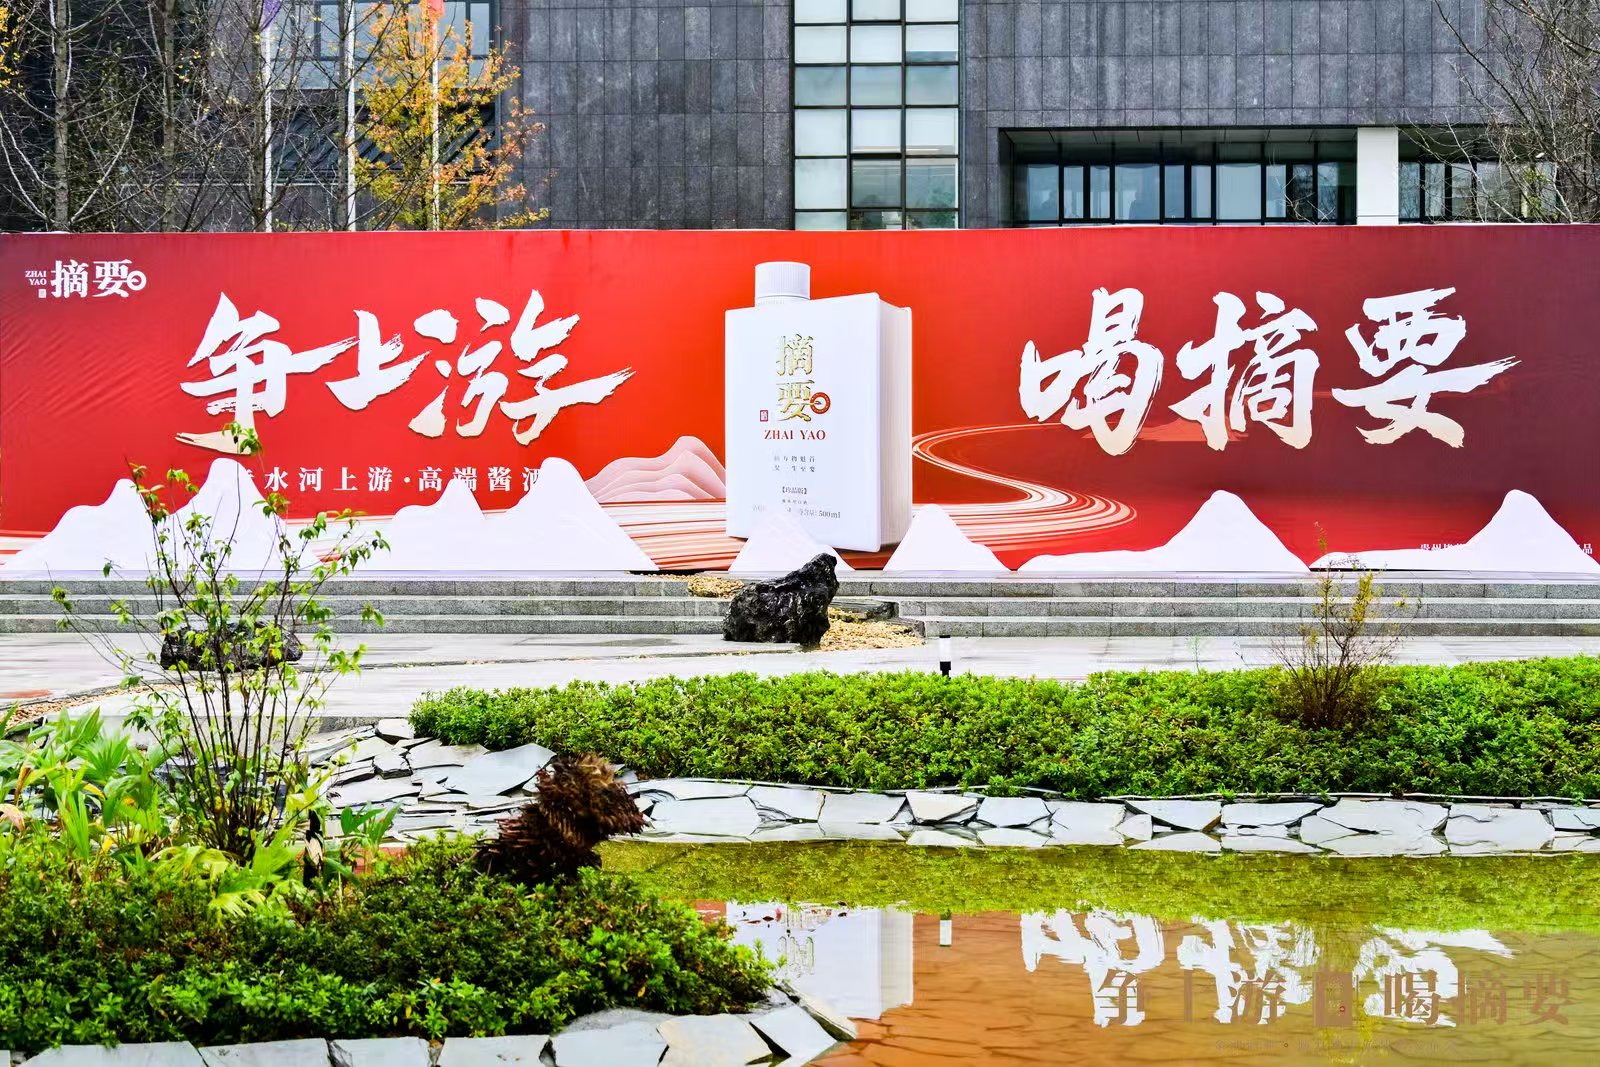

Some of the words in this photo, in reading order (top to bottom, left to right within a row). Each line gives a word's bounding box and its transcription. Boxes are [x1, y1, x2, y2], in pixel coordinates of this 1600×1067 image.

[25, 270, 47, 279] ZHAI
[29, 278, 47, 286] YAO
[50, 258, 147, 298] 摘要
[175, 289, 634, 455] 争上游
[775, 333, 830, 422] 摘要
[1018, 287, 1521, 457] 喝摘要
[764, 429, 794, 441] ZHAI
[799, 429, 826, 441] YAO
[246, 466, 541, 492] 水河上游·高端酱酒
